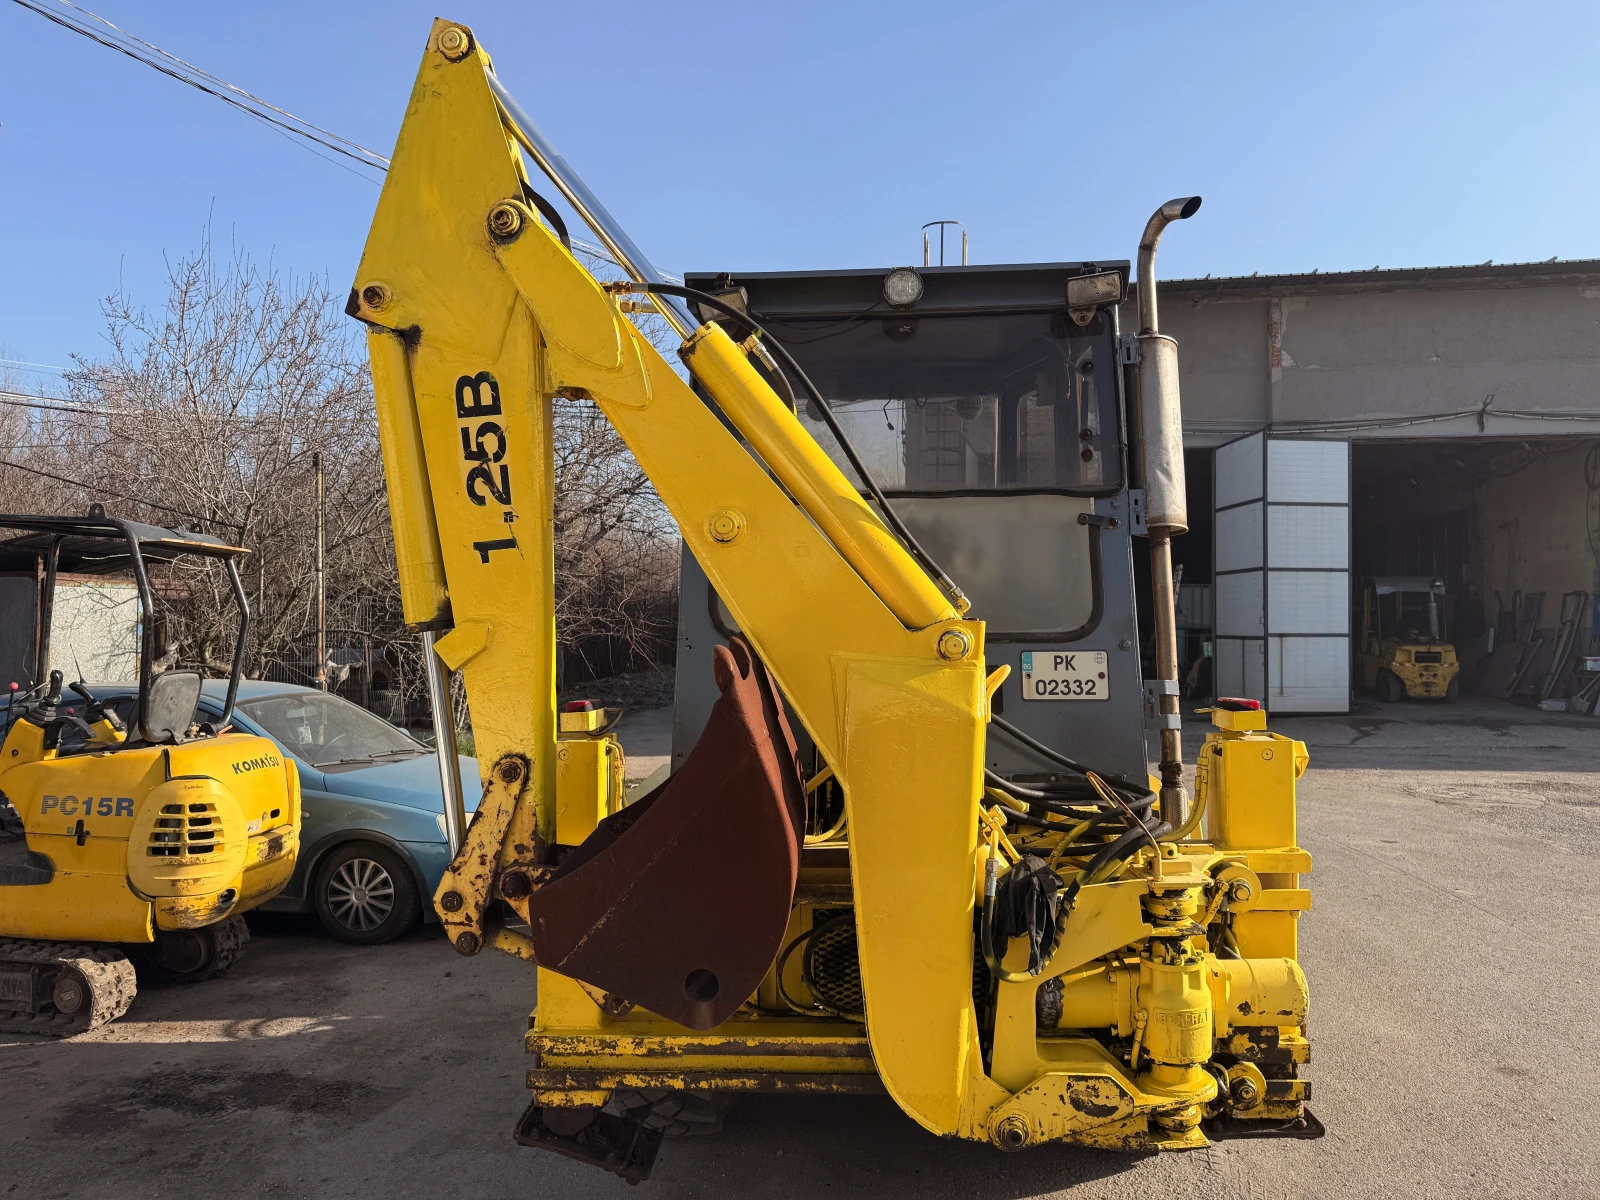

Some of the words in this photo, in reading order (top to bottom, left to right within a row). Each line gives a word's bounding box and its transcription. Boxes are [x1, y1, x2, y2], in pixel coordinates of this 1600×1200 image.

[1053, 655, 1077, 671] PK
[1035, 679, 1097, 696] 02332
[231, 753, 280, 775] KOMATSU
[41, 794, 135, 817] PC15R
